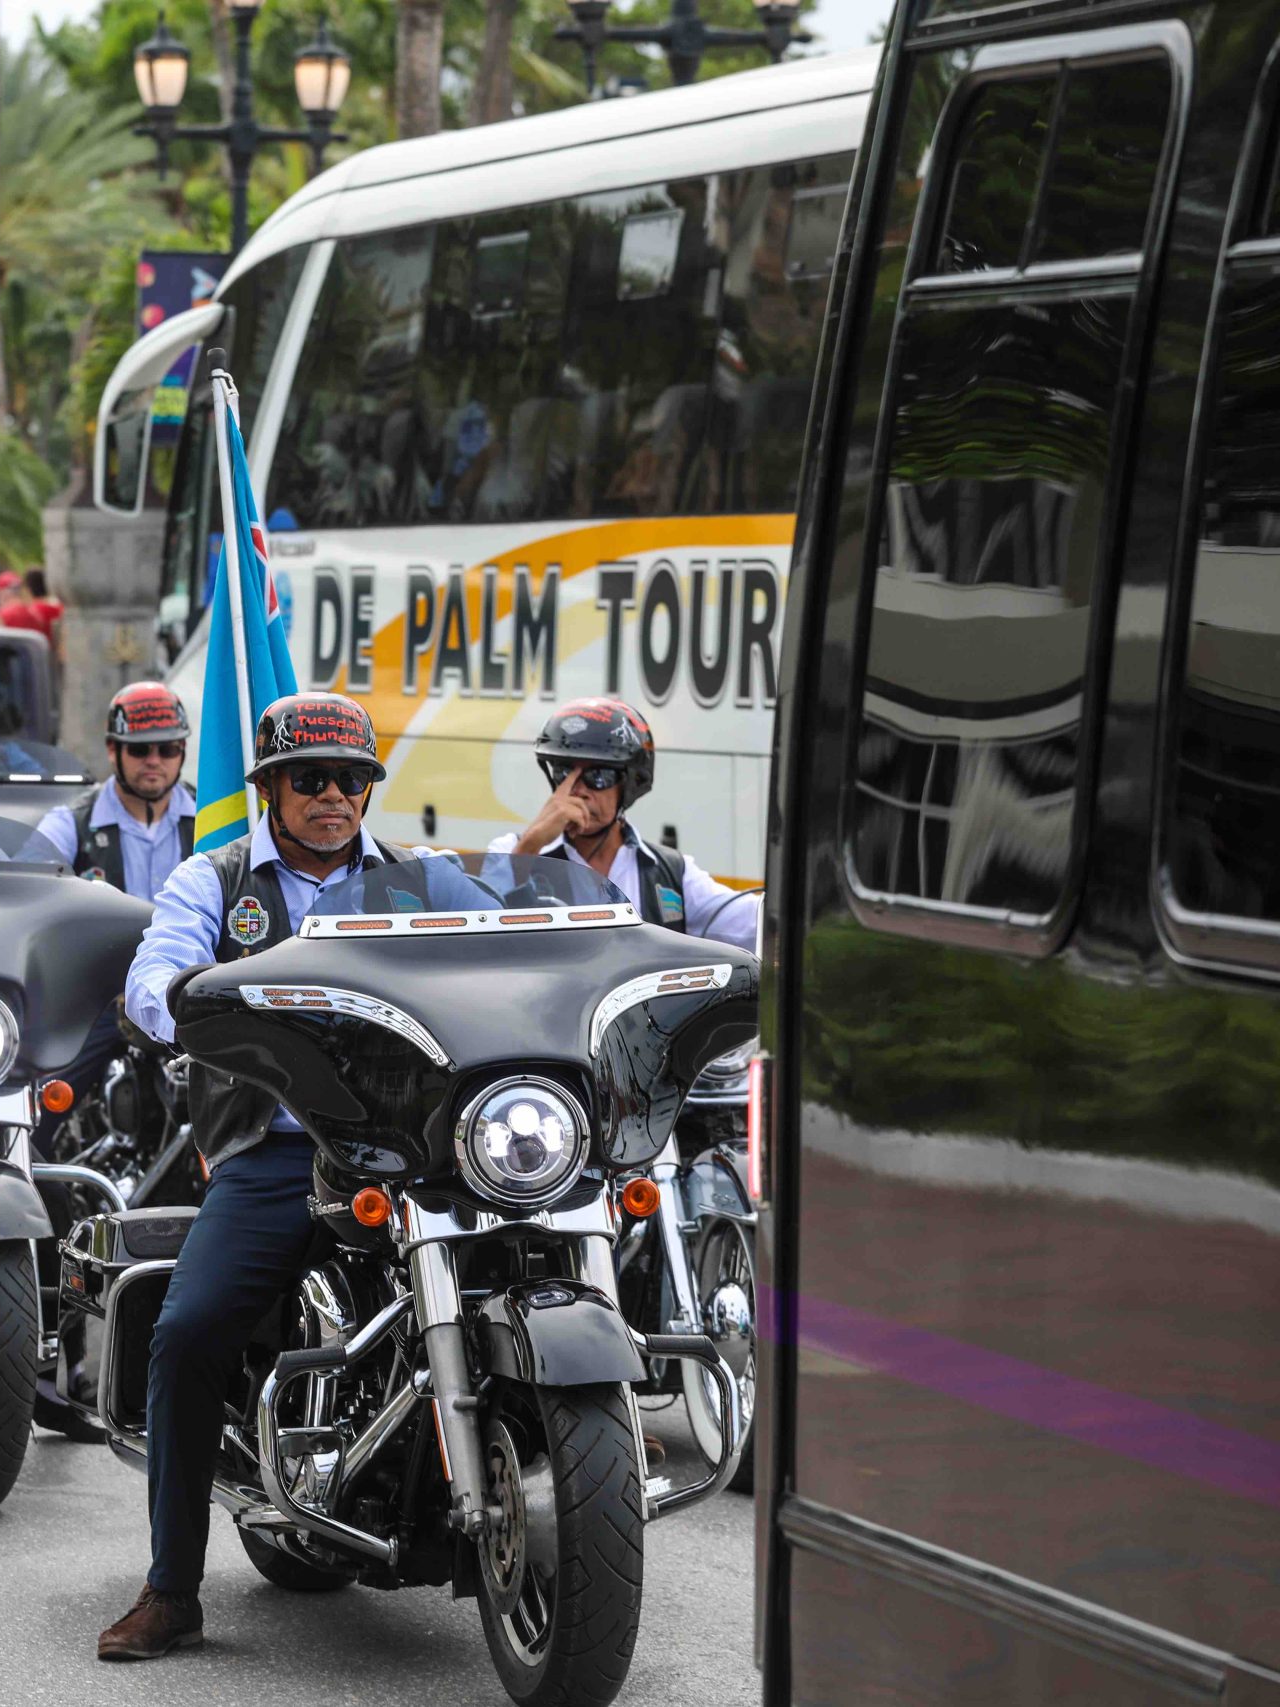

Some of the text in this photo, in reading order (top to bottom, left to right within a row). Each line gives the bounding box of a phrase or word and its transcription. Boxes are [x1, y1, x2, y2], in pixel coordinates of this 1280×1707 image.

[310, 557, 778, 711] DE PALM TOUR
[297, 715, 364, 734] Tuesday
[293, 729, 366, 746] Thunder
